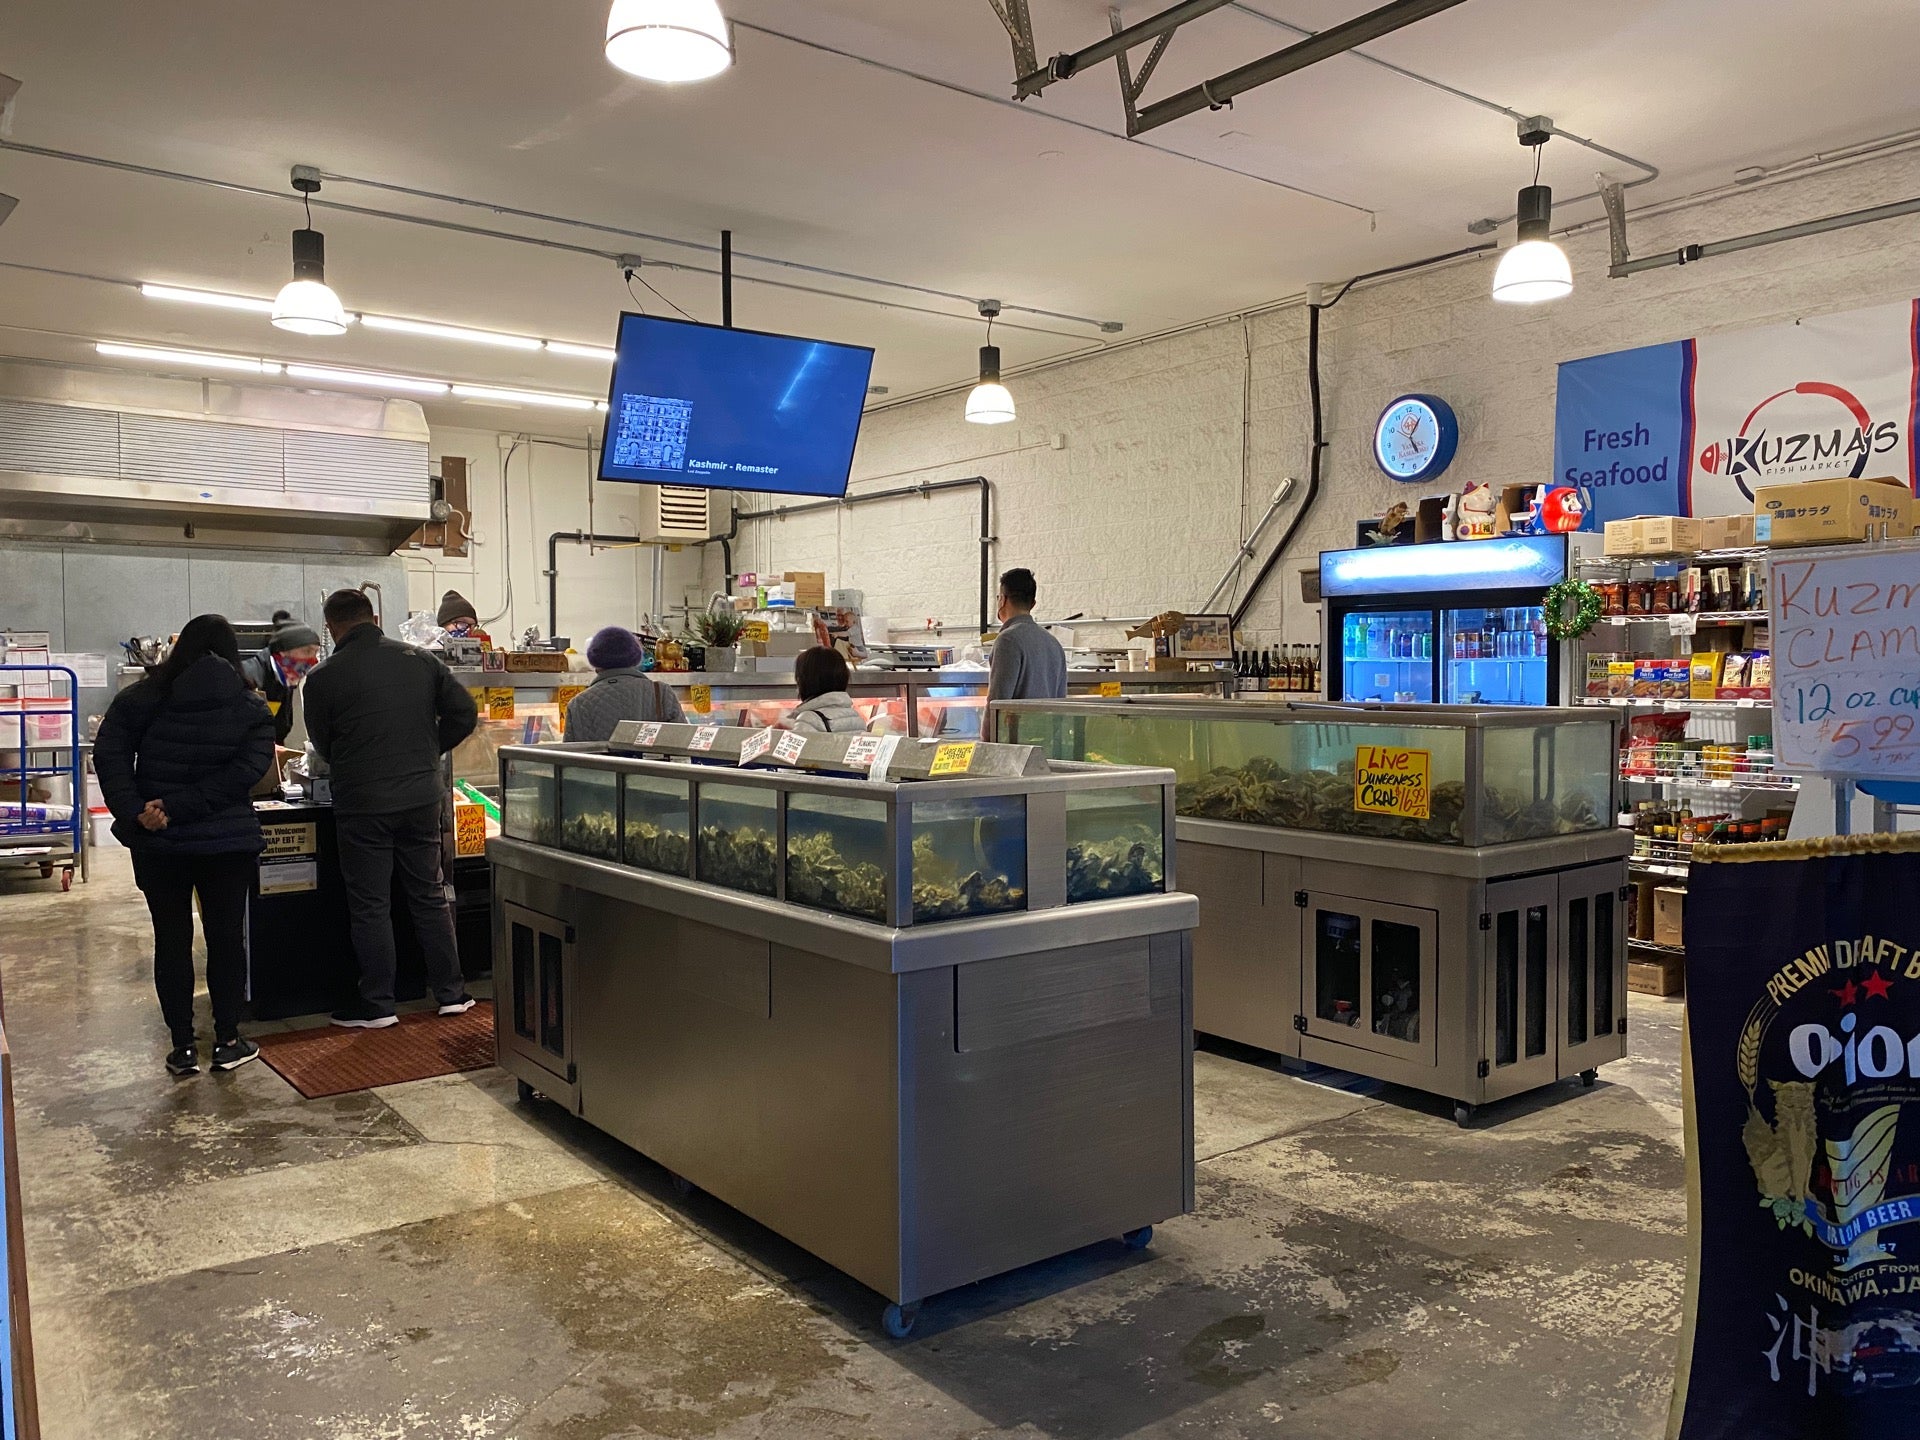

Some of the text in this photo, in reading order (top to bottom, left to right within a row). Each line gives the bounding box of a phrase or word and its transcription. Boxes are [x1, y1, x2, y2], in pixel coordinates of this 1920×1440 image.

[1584, 423, 1650, 452] Fresh
[1726, 421, 1899, 475] KUZMA'S
[689, 459, 727, 470] Kashmir
[735, 463, 778, 474] Remaster
[1565, 457, 1668, 488] Seafood
[1766, 460, 1850, 476] FISH MARKET
[1774, 505, 1831, 519] 海藻サラダ
[1798, 683, 1836, 724] 12
[1368, 747, 1409, 770] Live
[274, 827, 306, 836] Welcome
[265, 846, 300, 854] ustomers
[1866, 1201, 1913, 1228] BEER
[1878, 1264, 1920, 1274] FROM
